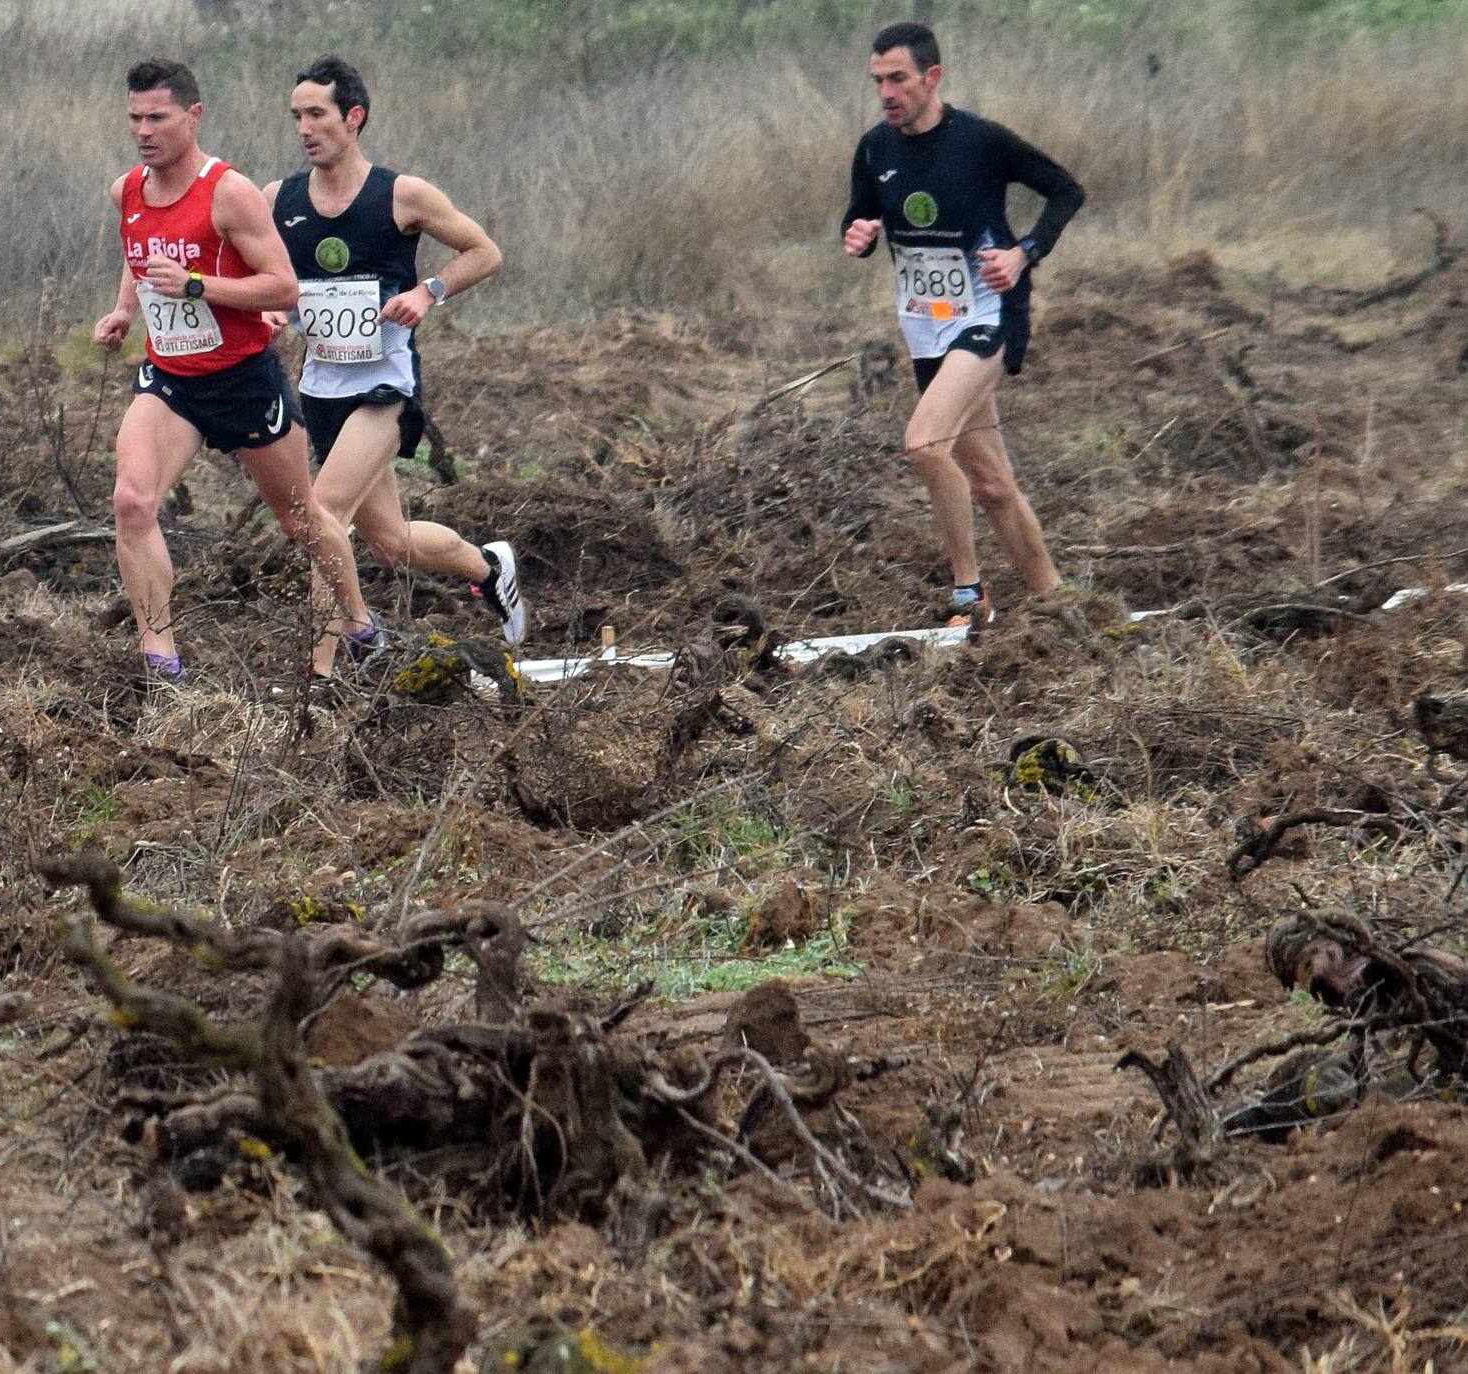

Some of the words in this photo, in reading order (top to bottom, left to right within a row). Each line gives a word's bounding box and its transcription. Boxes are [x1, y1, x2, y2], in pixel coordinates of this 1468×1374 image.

[127, 237, 143, 257] La
[147, 237, 201, 268] Rioja
[899, 266, 965, 297] 1689
[148, 301, 199, 331] 378
[303, 307, 378, 338] 2308
[165, 337, 214, 352] ATLETISMO
[326, 349, 373, 361] ATLETISMO
